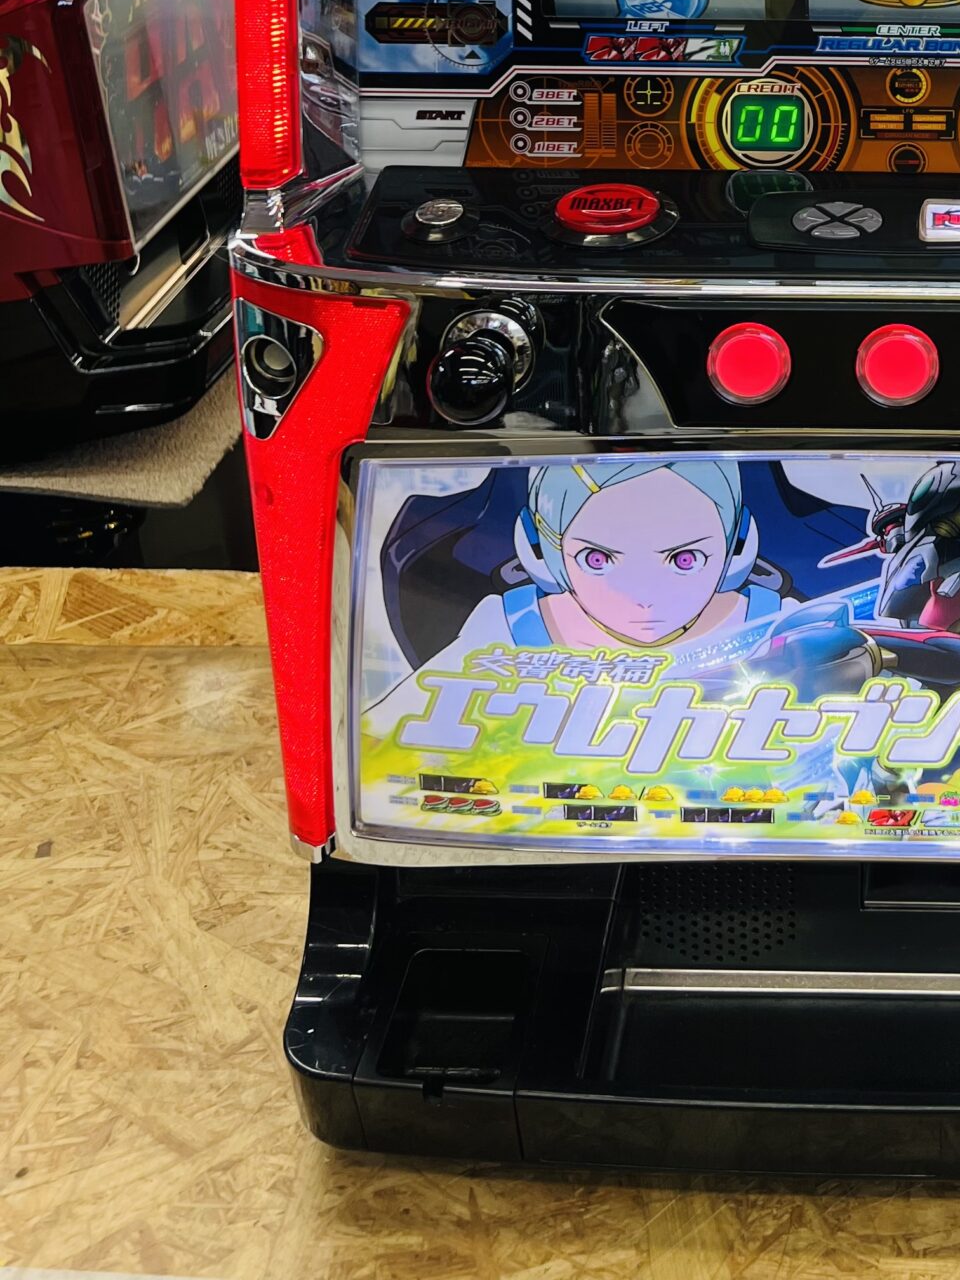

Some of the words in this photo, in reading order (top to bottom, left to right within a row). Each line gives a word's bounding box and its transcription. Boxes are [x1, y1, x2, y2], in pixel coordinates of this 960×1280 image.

[626, 21, 669, 32] LEFT
[876, 24, 941, 37] CENTER
[816, 36, 925, 54] REGULAR
[532, 89, 577, 101] 3BET
[735, 83, 801, 95] CREDIT
[415, 110, 465, 121] START
[532, 116, 577, 128] 2BET
[533, 142, 577, 153] 1BET
[568, 196, 648, 211] MAXBET
[470, 648, 667, 686] 交響詩篇
